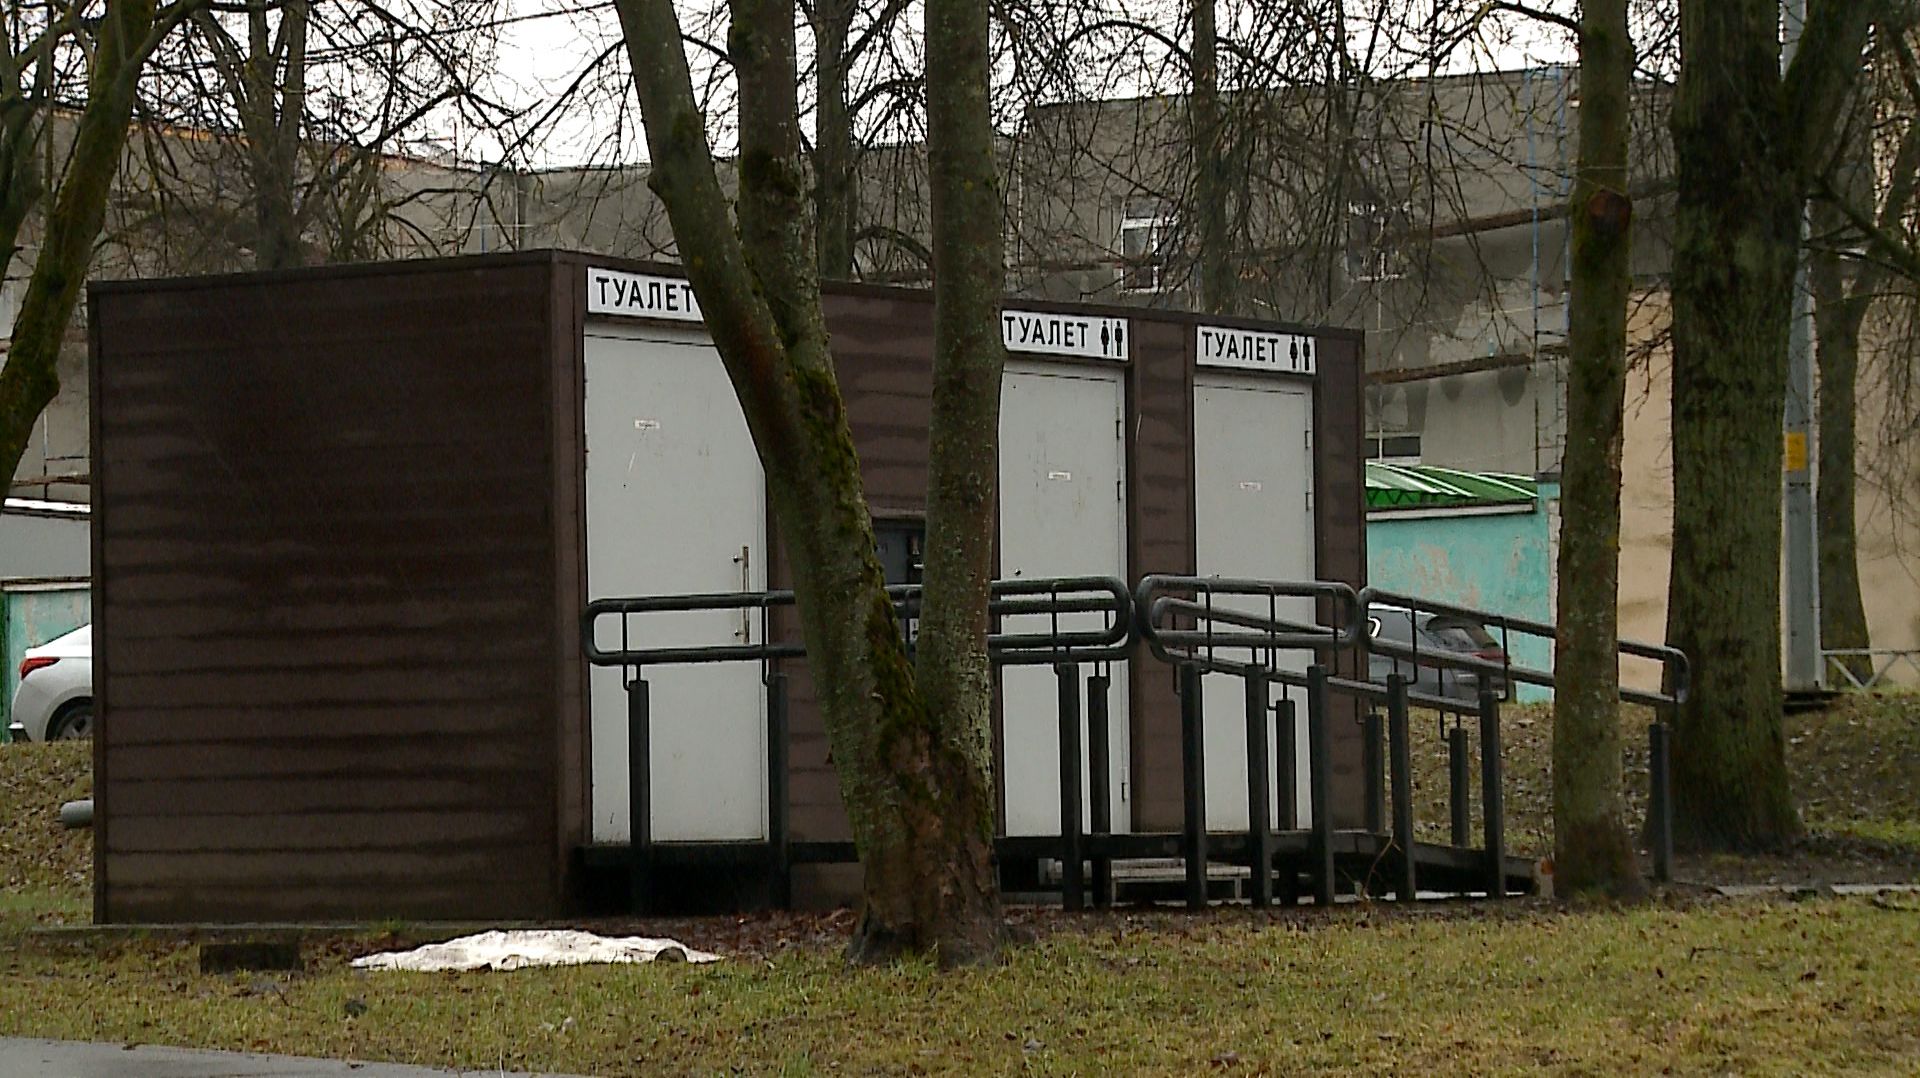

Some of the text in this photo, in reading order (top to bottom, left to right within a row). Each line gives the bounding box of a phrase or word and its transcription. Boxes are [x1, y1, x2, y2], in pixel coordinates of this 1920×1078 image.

[596, 276, 691, 312] ТУАЛЕТ
[1003, 316, 1088, 348] ТУАЛЕТ
[1202, 331, 1278, 363] ТУАЛЕТ
